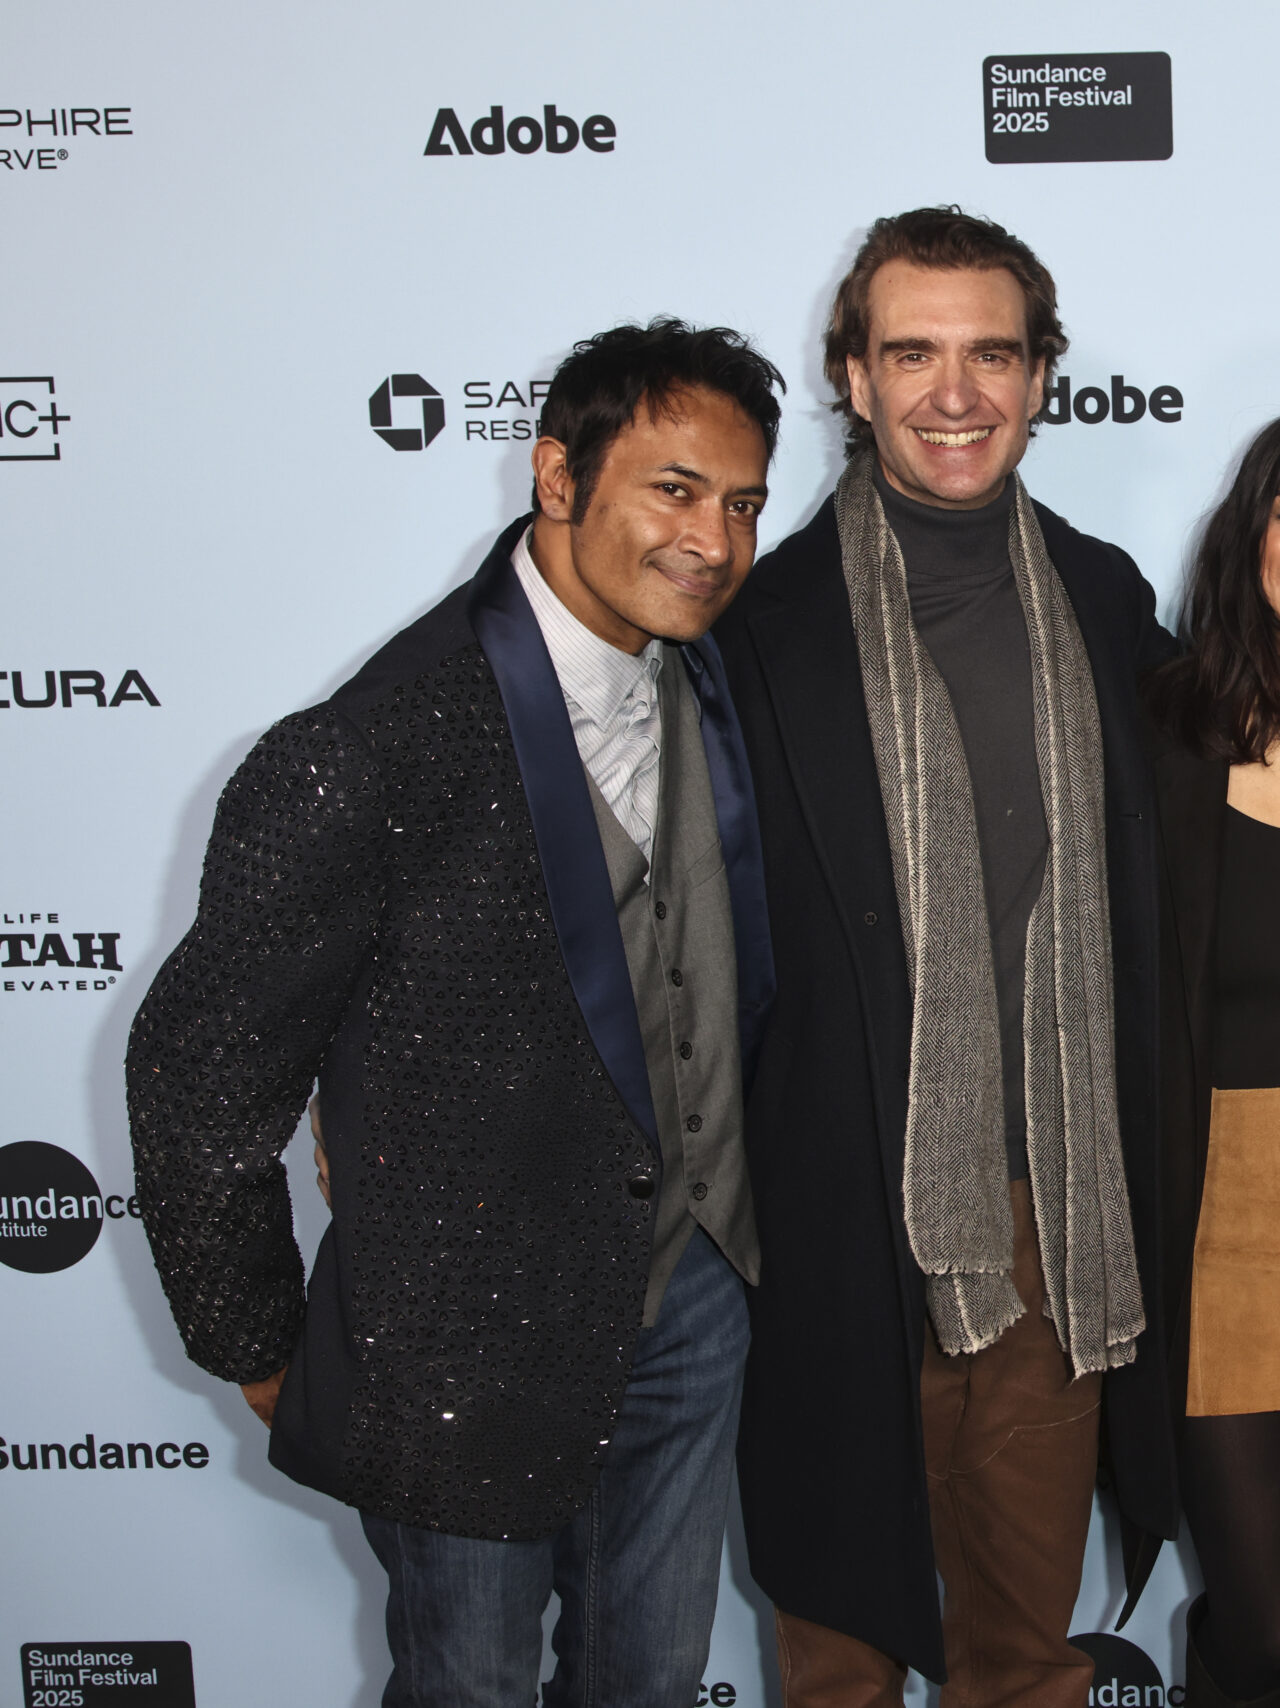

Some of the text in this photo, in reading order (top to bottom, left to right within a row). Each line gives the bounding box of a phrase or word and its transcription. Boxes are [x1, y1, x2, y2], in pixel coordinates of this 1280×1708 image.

[990, 63, 1107, 84] Sundance
[992, 85, 1132, 108] Film Festival
[423, 104, 617, 156] Adobe
[992, 112, 1050, 133] 2025
[1031, 375, 1184, 425] dobe
[0, 400, 71, 438] C+
[0, 669, 162, 708] URA
[3, 913, 59, 924] LIFE
[0, 1222, 48, 1237] titute
[28, 1650, 134, 1667] Sundance
[30, 1668, 158, 1686] Film Festival
[32, 1689, 84, 1707] 2025
